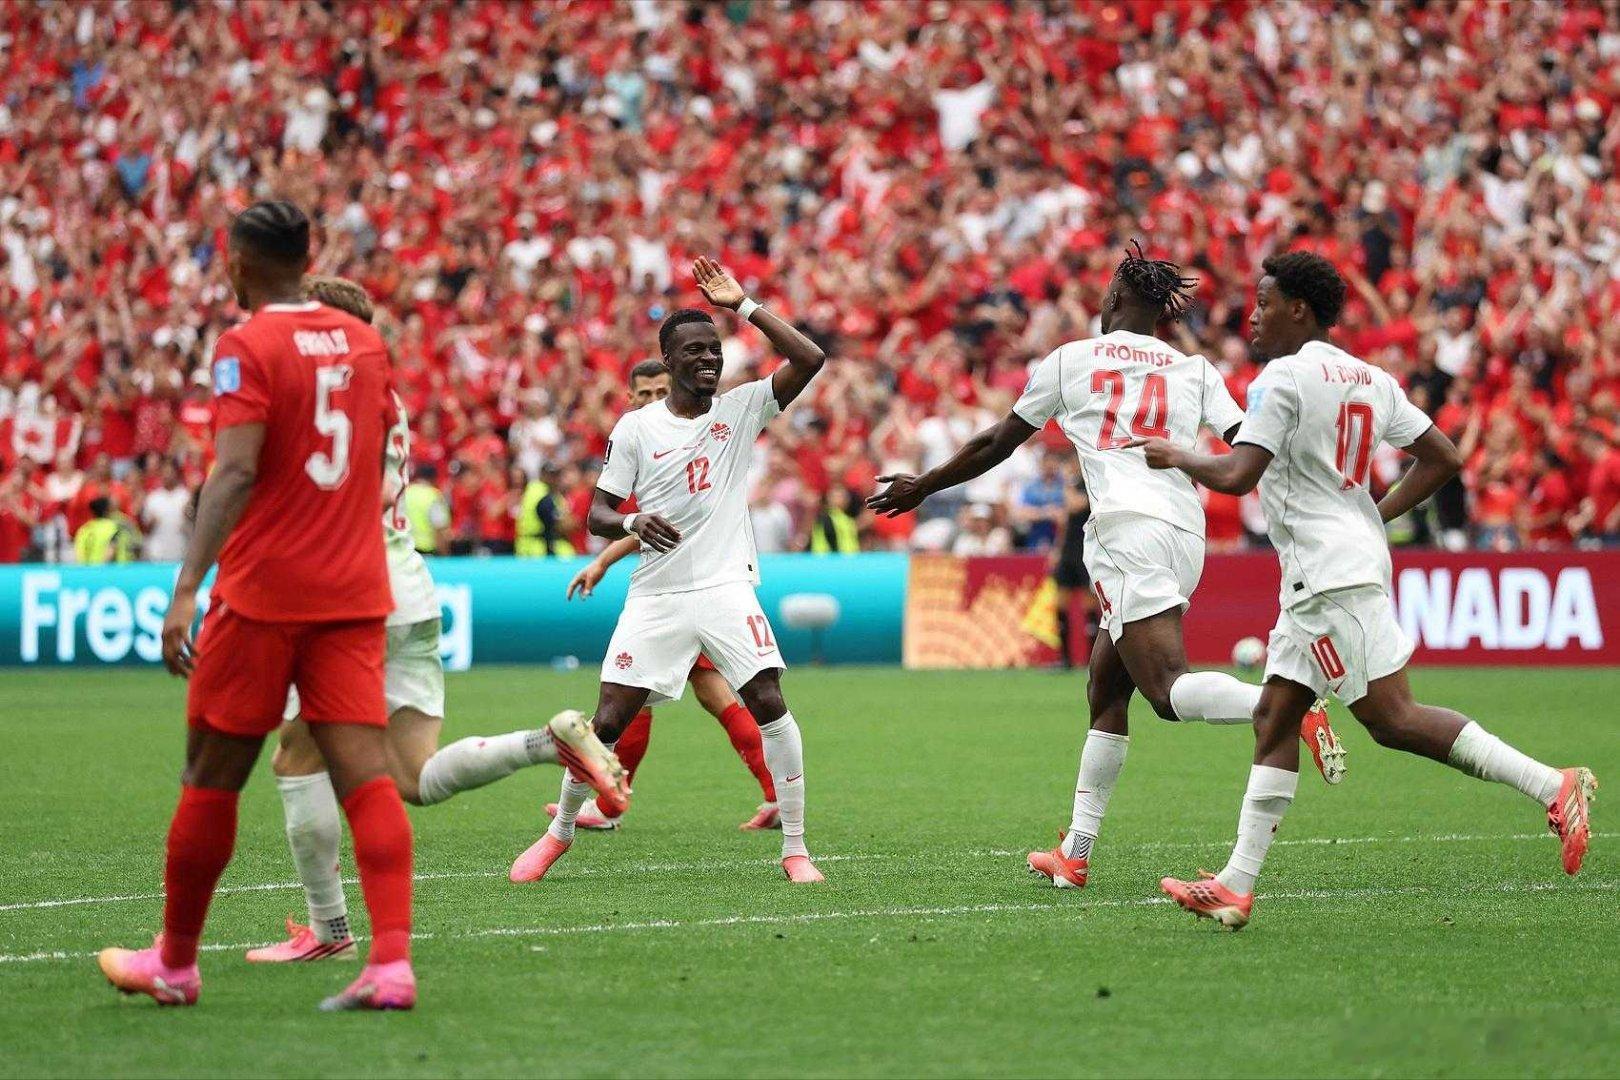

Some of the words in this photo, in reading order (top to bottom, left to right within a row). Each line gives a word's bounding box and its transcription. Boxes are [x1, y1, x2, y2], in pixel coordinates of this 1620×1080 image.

[305, 363, 353, 490] 5
[1090, 369, 1171, 451] 24
[1335, 402, 1374, 491] 10
[686, 456, 711, 495] 12
[20, 571, 212, 663] Fres
[746, 614, 775, 648] 12
[1390, 567, 1604, 650] NADA
[1309, 635, 1346, 682] 10
